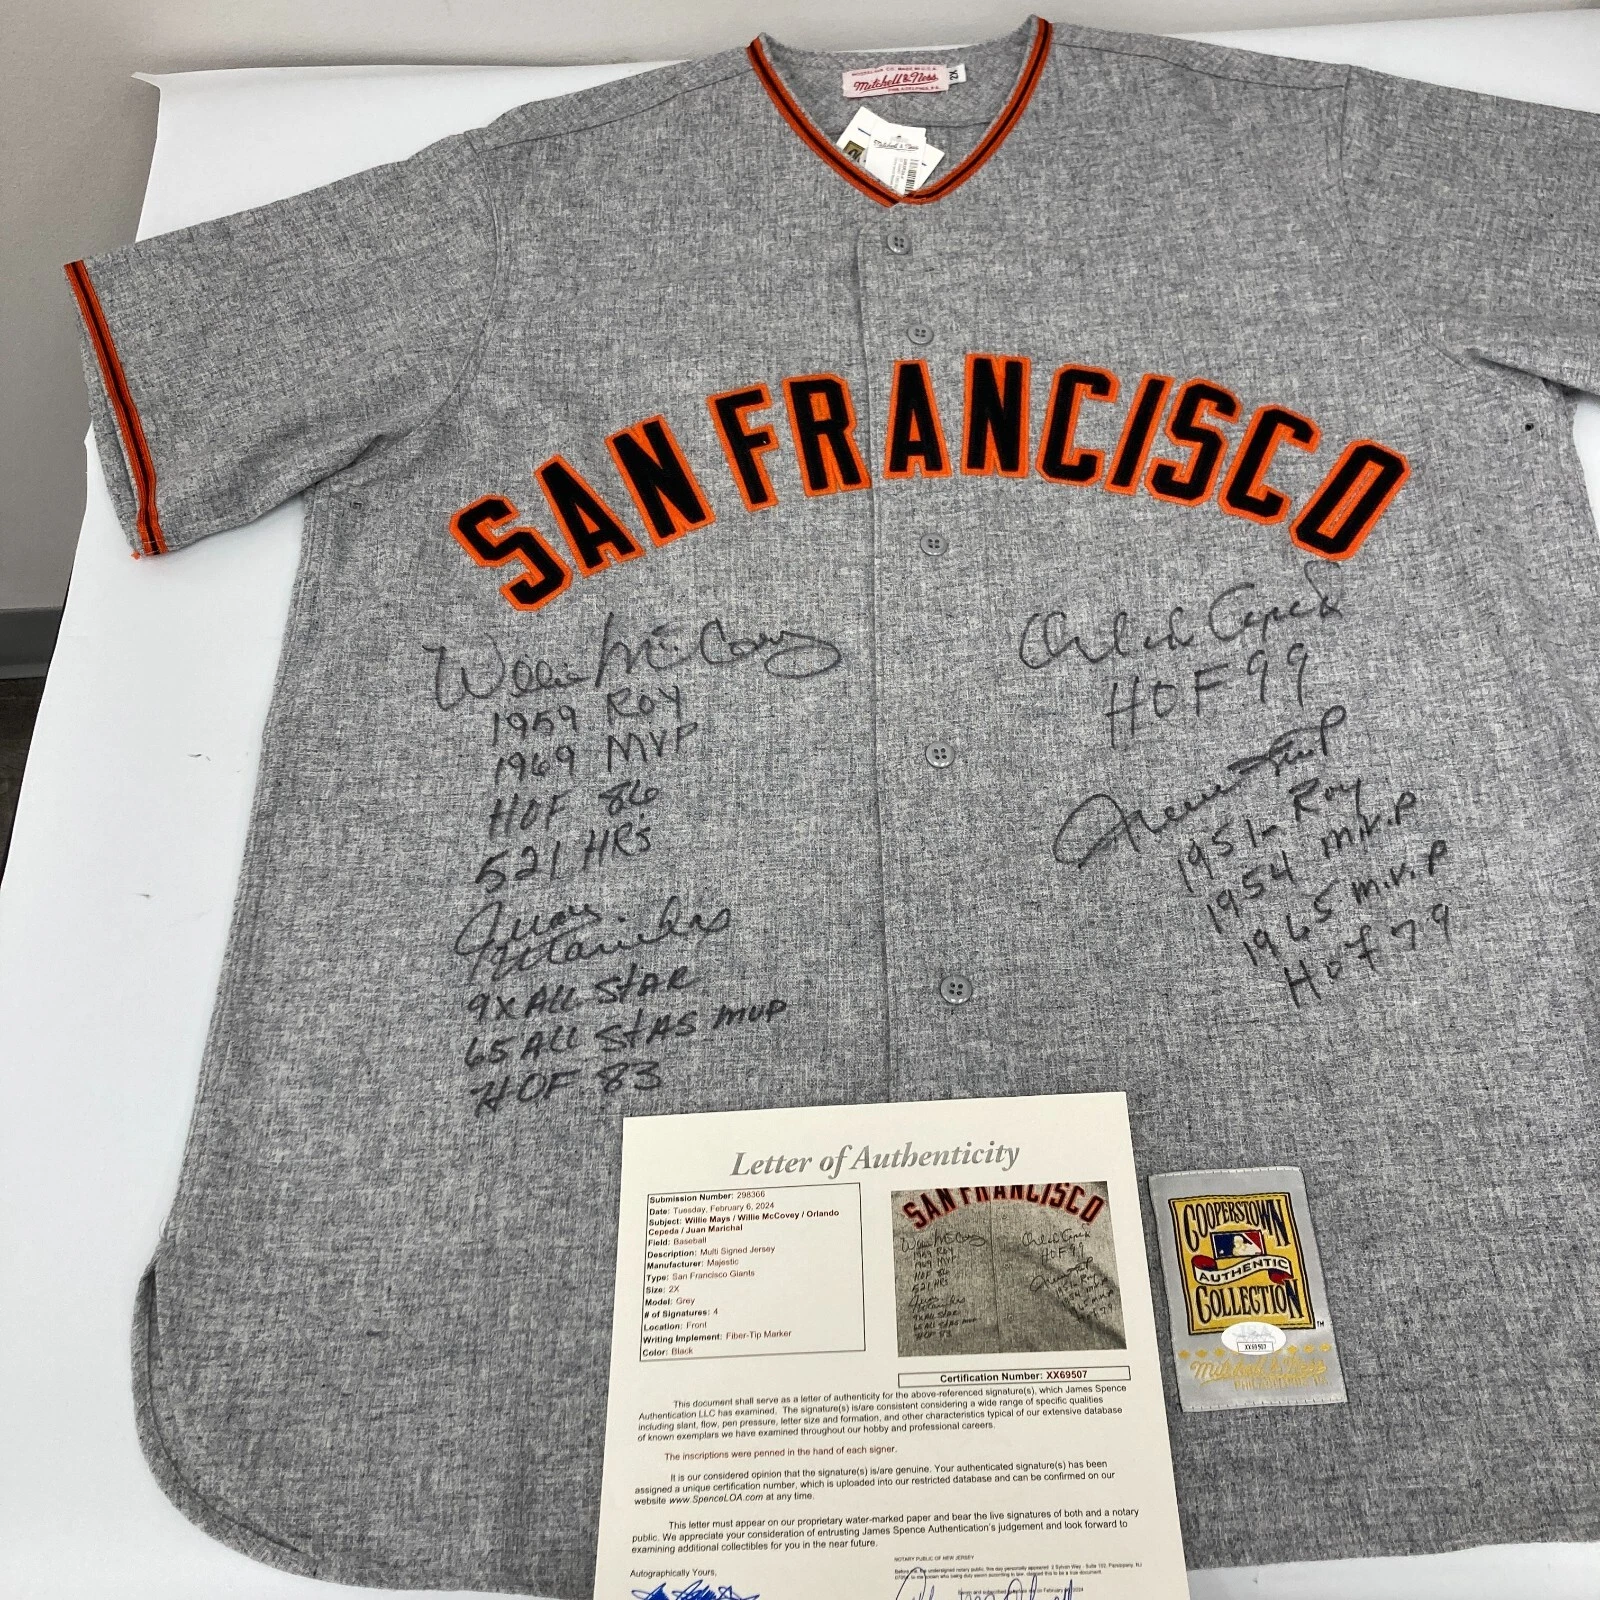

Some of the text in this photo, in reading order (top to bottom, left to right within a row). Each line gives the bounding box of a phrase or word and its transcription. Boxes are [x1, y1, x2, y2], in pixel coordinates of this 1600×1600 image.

[854, 72, 938, 91] Mitchell & Ness
[447, 353, 1411, 611] SAN FRANCISCO
[1105, 642, 1309, 750] HOF 99
[491, 705, 578, 746] 1959
[494, 721, 698, 785] 1969 MVP
[489, 788, 572, 839] HOF
[476, 841, 560, 894] 521
[1207, 849, 1298, 934] 1954
[1243, 879, 1342, 967] 1965
[1391, 902, 1451, 951] 79
[463, 1036, 517, 1069] 65
[596, 1060, 662, 1094] 83
[731, 1140, 1020, 1180] Letter of Authenticity
[649, 1190, 766, 1204] Submission Number: 298366
[649, 1201, 775, 1215] Date: Tuesday, February 6, 2024
[649, 1208, 840, 1227] Subject: Willie Mays / Willie McCovey / Orlando
[902, 1187, 957, 1230] SAN
[648, 1223, 743, 1237] Cepeda / Juan Marichal
[1183, 1198, 1292, 1253] COOPERSTOWN
[648, 1236, 707, 1246] Field: Baseball
[647, 1244, 776, 1260] Description: Multi Signed Jersey
[646, 1257, 739, 1269] Manufacturer: Majestic
[1199, 1257, 1290, 1284] AUTHENTIC
[646, 1268, 755, 1283] Type: San Francisco Giants
[645, 1284, 680, 1294] Size: 2X
[645, 1296, 696, 1306] Model: Grey
[1195, 1279, 1304, 1325] COLLECTION
[644, 1307, 718, 1319] # of Signatures: 4
[643, 1320, 707, 1331] Location: Front
[643, 1329, 792, 1345] Writing Implement: Fiber-Tip Marker
[642, 1346, 693, 1356] Color: Black
[940, 1369, 1088, 1383] Certification Number: XX69507
[673, 1400, 691, 1408] This
[692, 1398, 733, 1407] document
[735, 1397, 754, 1406] shall
[800, 1395, 822, 1403] letter
[823, 1394, 832, 1402] of
[833, 1392, 881, 1403] authenticity
[882, 1392, 894, 1400] for
[895, 1391, 909, 1400] the
[911, 1389, 983, 1399] above-referenced
[985, 1387, 1037, 1398] signature(s),
[1038, 1386, 1063, 1395] which
[1065, 1385, 1093, 1394] James
[1095, 1384, 1127, 1394] Spence
[664, 1452, 680, 1461] The
[682, 1451, 729, 1462] inscriptions
[754, 1449, 785, 1459] penned
[787, 1448, 795, 1456] in
[797, 1448, 811, 1456] the
[812, 1447, 834, 1455] hand
[836, 1447, 845, 1455] of
[846, 1446, 867, 1454] each
[869, 1445, 898, 1455] signer.
[634, 1492, 815, 1505] website www.SpenceLOA.com at any time.
[629, 1568, 717, 1579] Autographically Yours,
